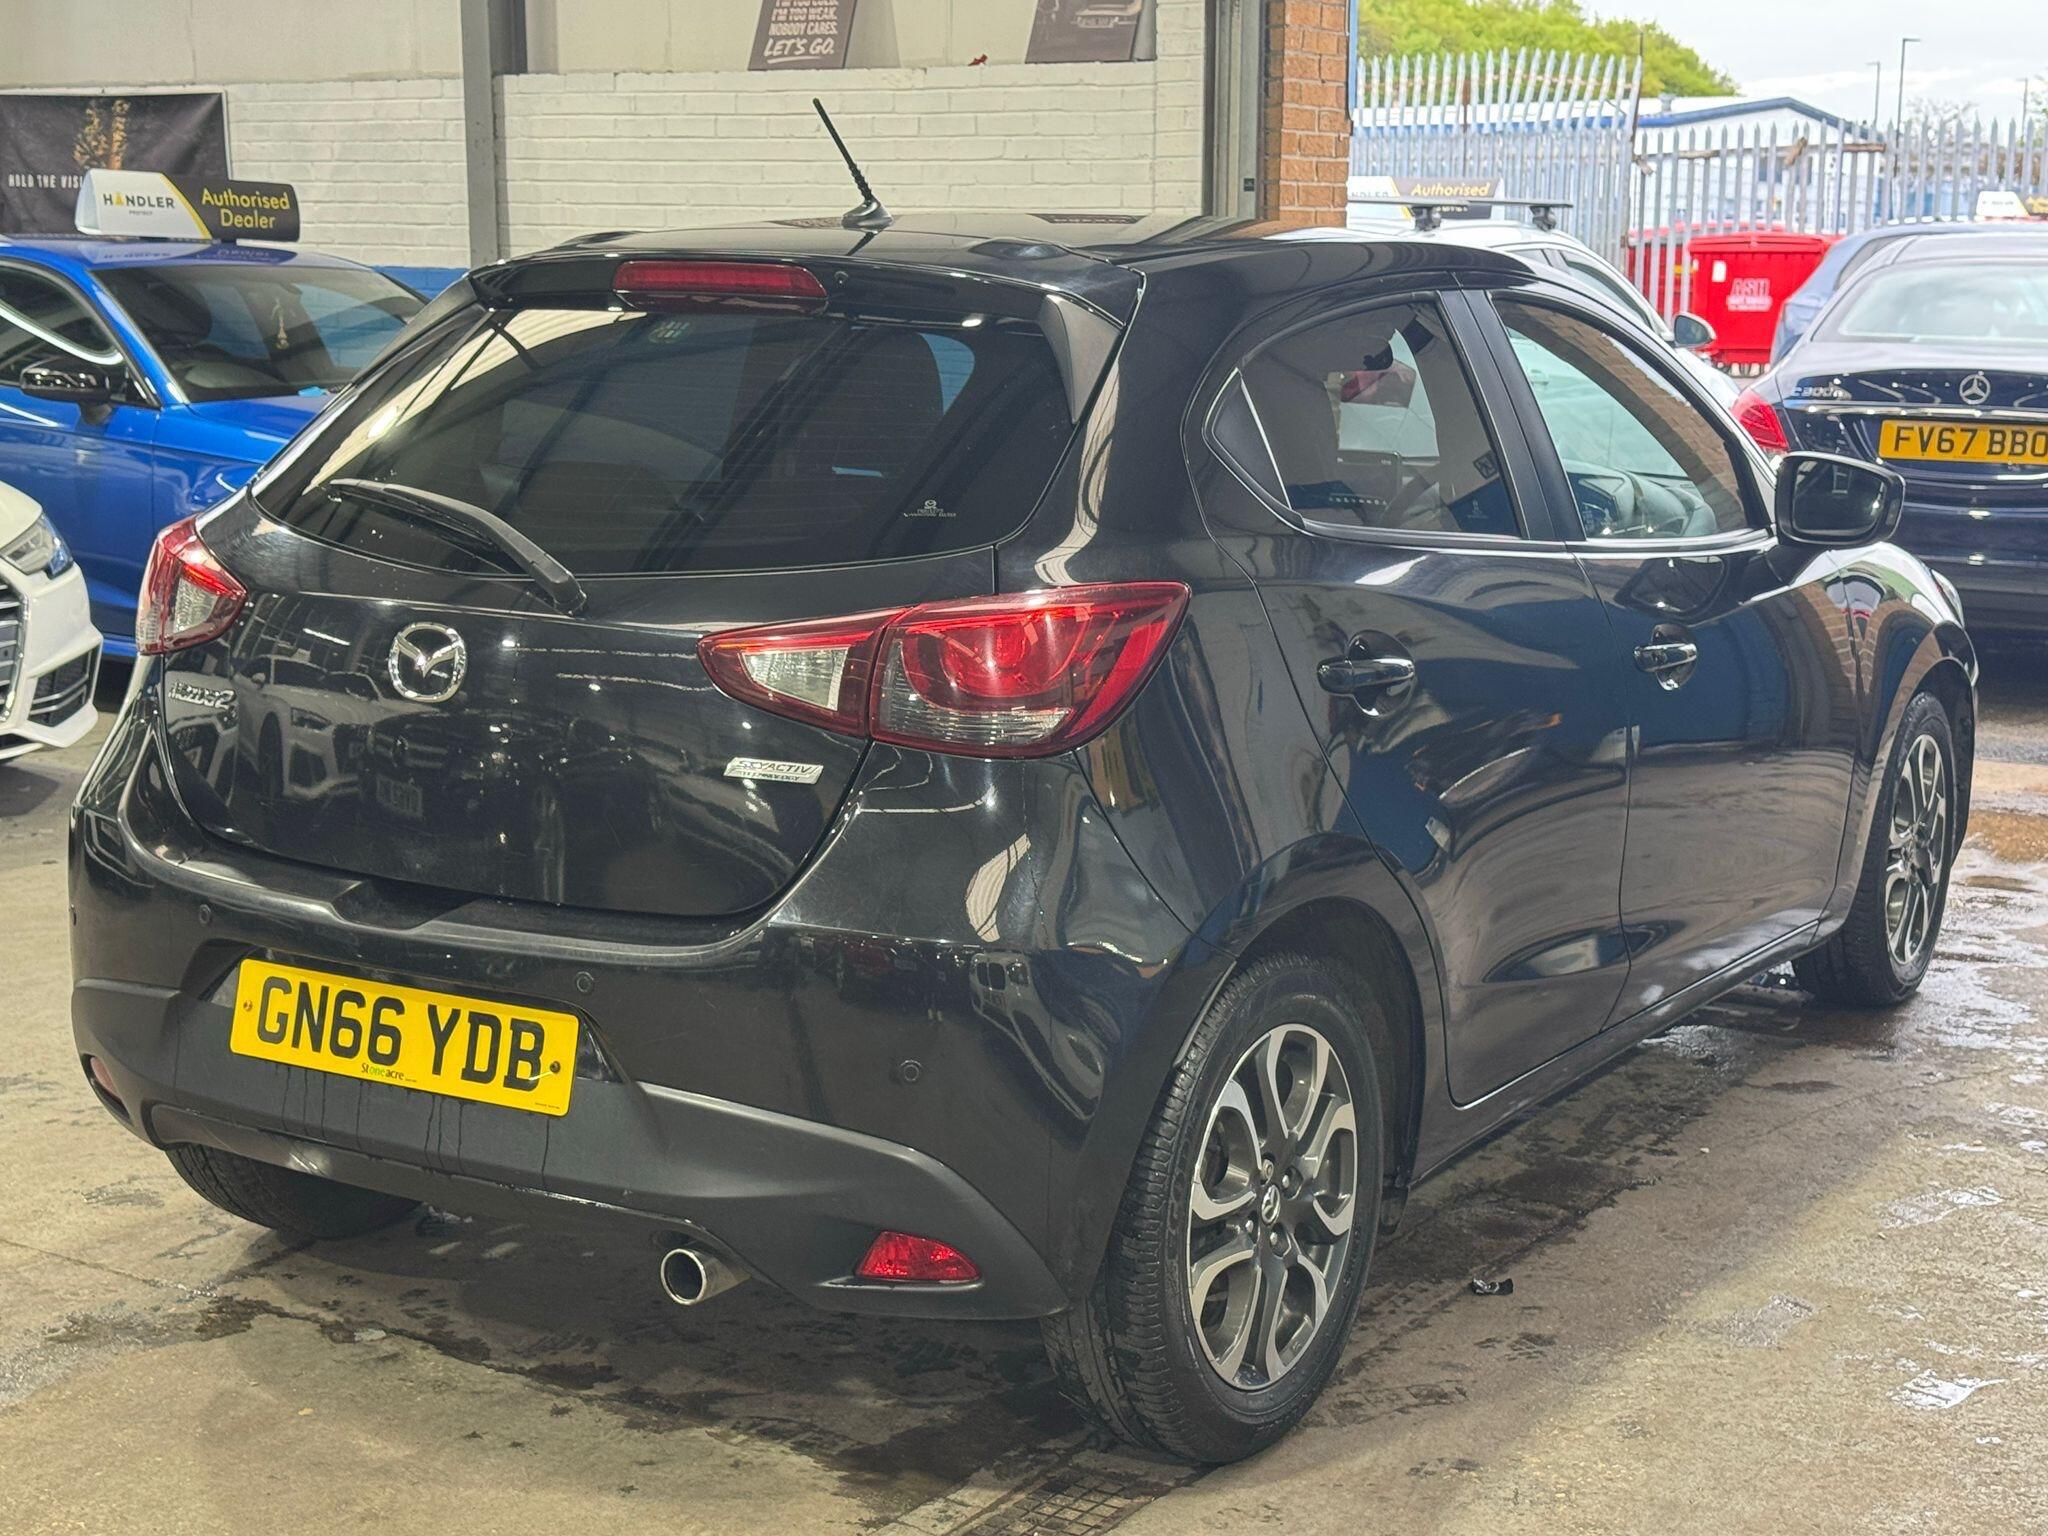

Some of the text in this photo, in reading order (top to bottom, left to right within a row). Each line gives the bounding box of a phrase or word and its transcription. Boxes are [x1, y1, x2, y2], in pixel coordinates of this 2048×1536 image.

[789, 8, 808, 21] TOO
[768, 22, 807, 36] NOBODY
[763, 37, 835, 57] LET'S GO.
[37, 174, 57, 189] THE
[61, 175, 83, 189] VISI
[1411, 182, 1491, 198] Authorised
[103, 193, 175, 209] HANDLER
[201, 187, 290, 210] Authorised
[220, 209, 276, 229] Dealer
[1894, 426, 1978, 456] FV67
[257, 975, 545, 1093] GN66 YDB
